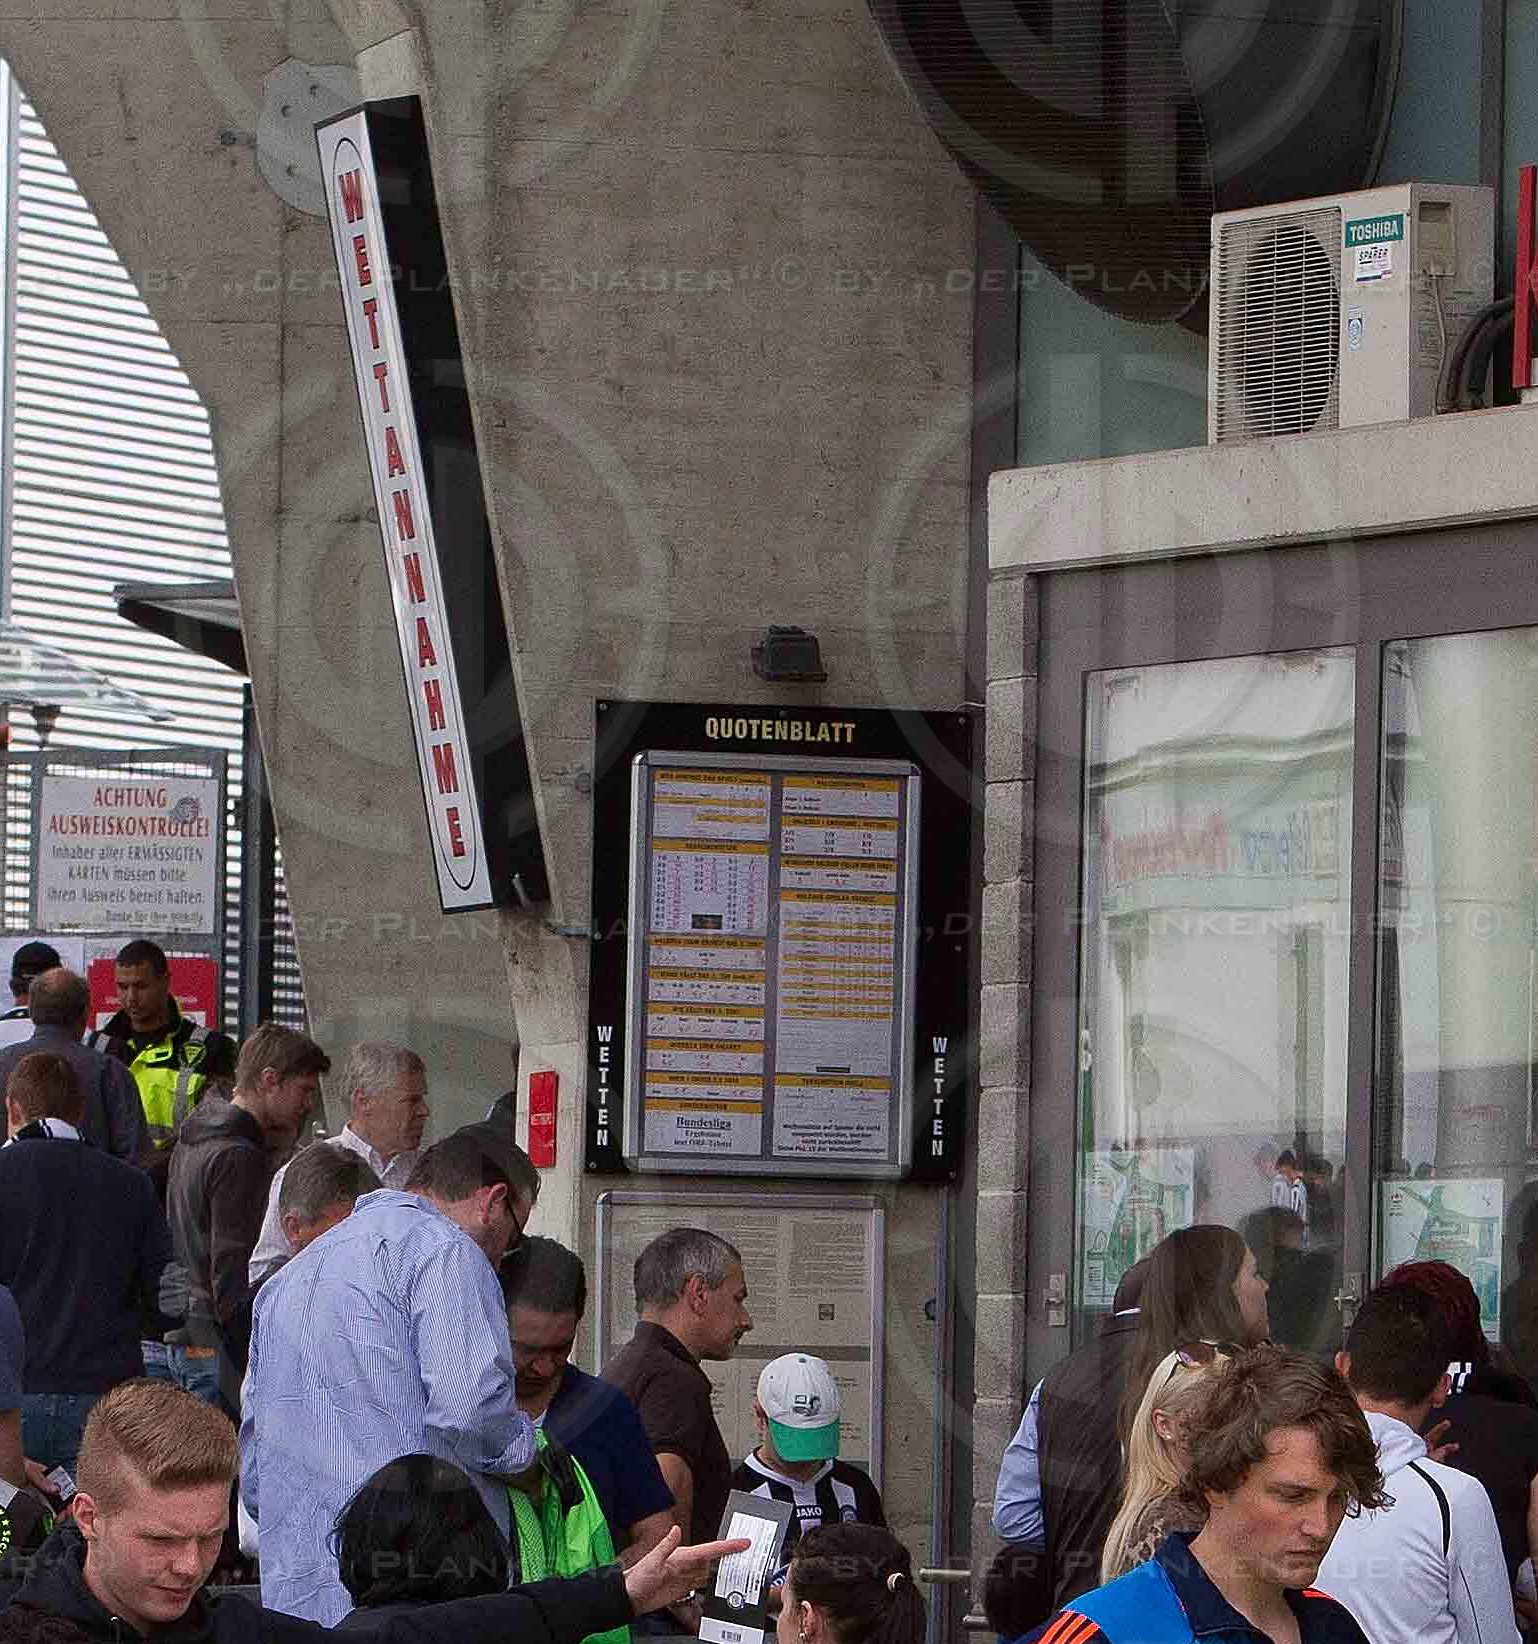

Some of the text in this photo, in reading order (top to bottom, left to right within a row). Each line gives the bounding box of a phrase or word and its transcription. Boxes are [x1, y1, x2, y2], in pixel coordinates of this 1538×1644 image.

[1349, 220, 1399, 241] TOSHIBA
[336, 170, 466, 858] WETTANNAHME
[705, 717, 856, 743] QUOTENBLATT
[93, 787, 166, 808] ACHTUNG
[593, 1025, 613, 1147] WETTEN
[931, 1036, 949, 1157] WETTEN
[796, 1506, 822, 1517] JAKO
